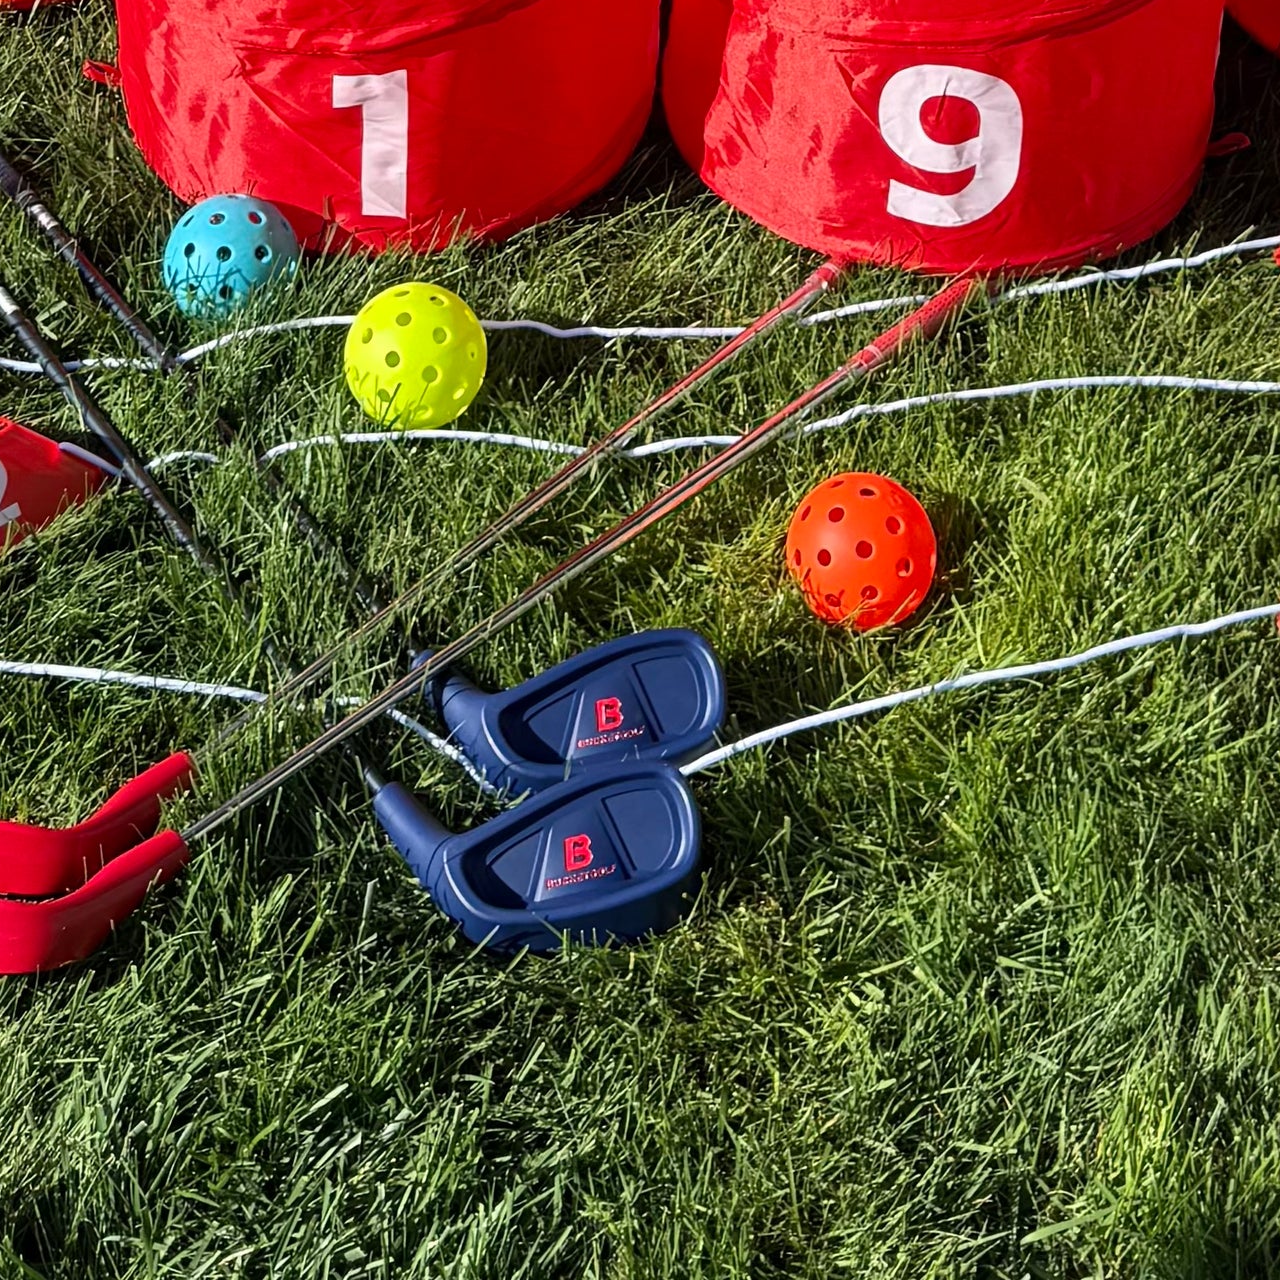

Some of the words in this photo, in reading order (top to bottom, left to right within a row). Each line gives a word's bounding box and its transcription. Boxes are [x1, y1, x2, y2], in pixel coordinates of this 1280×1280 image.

[332, 69, 409, 220] 1
[877, 64, 1024, 228] 9
[594, 696, 625, 732] B
[563, 834, 594, 872] B
